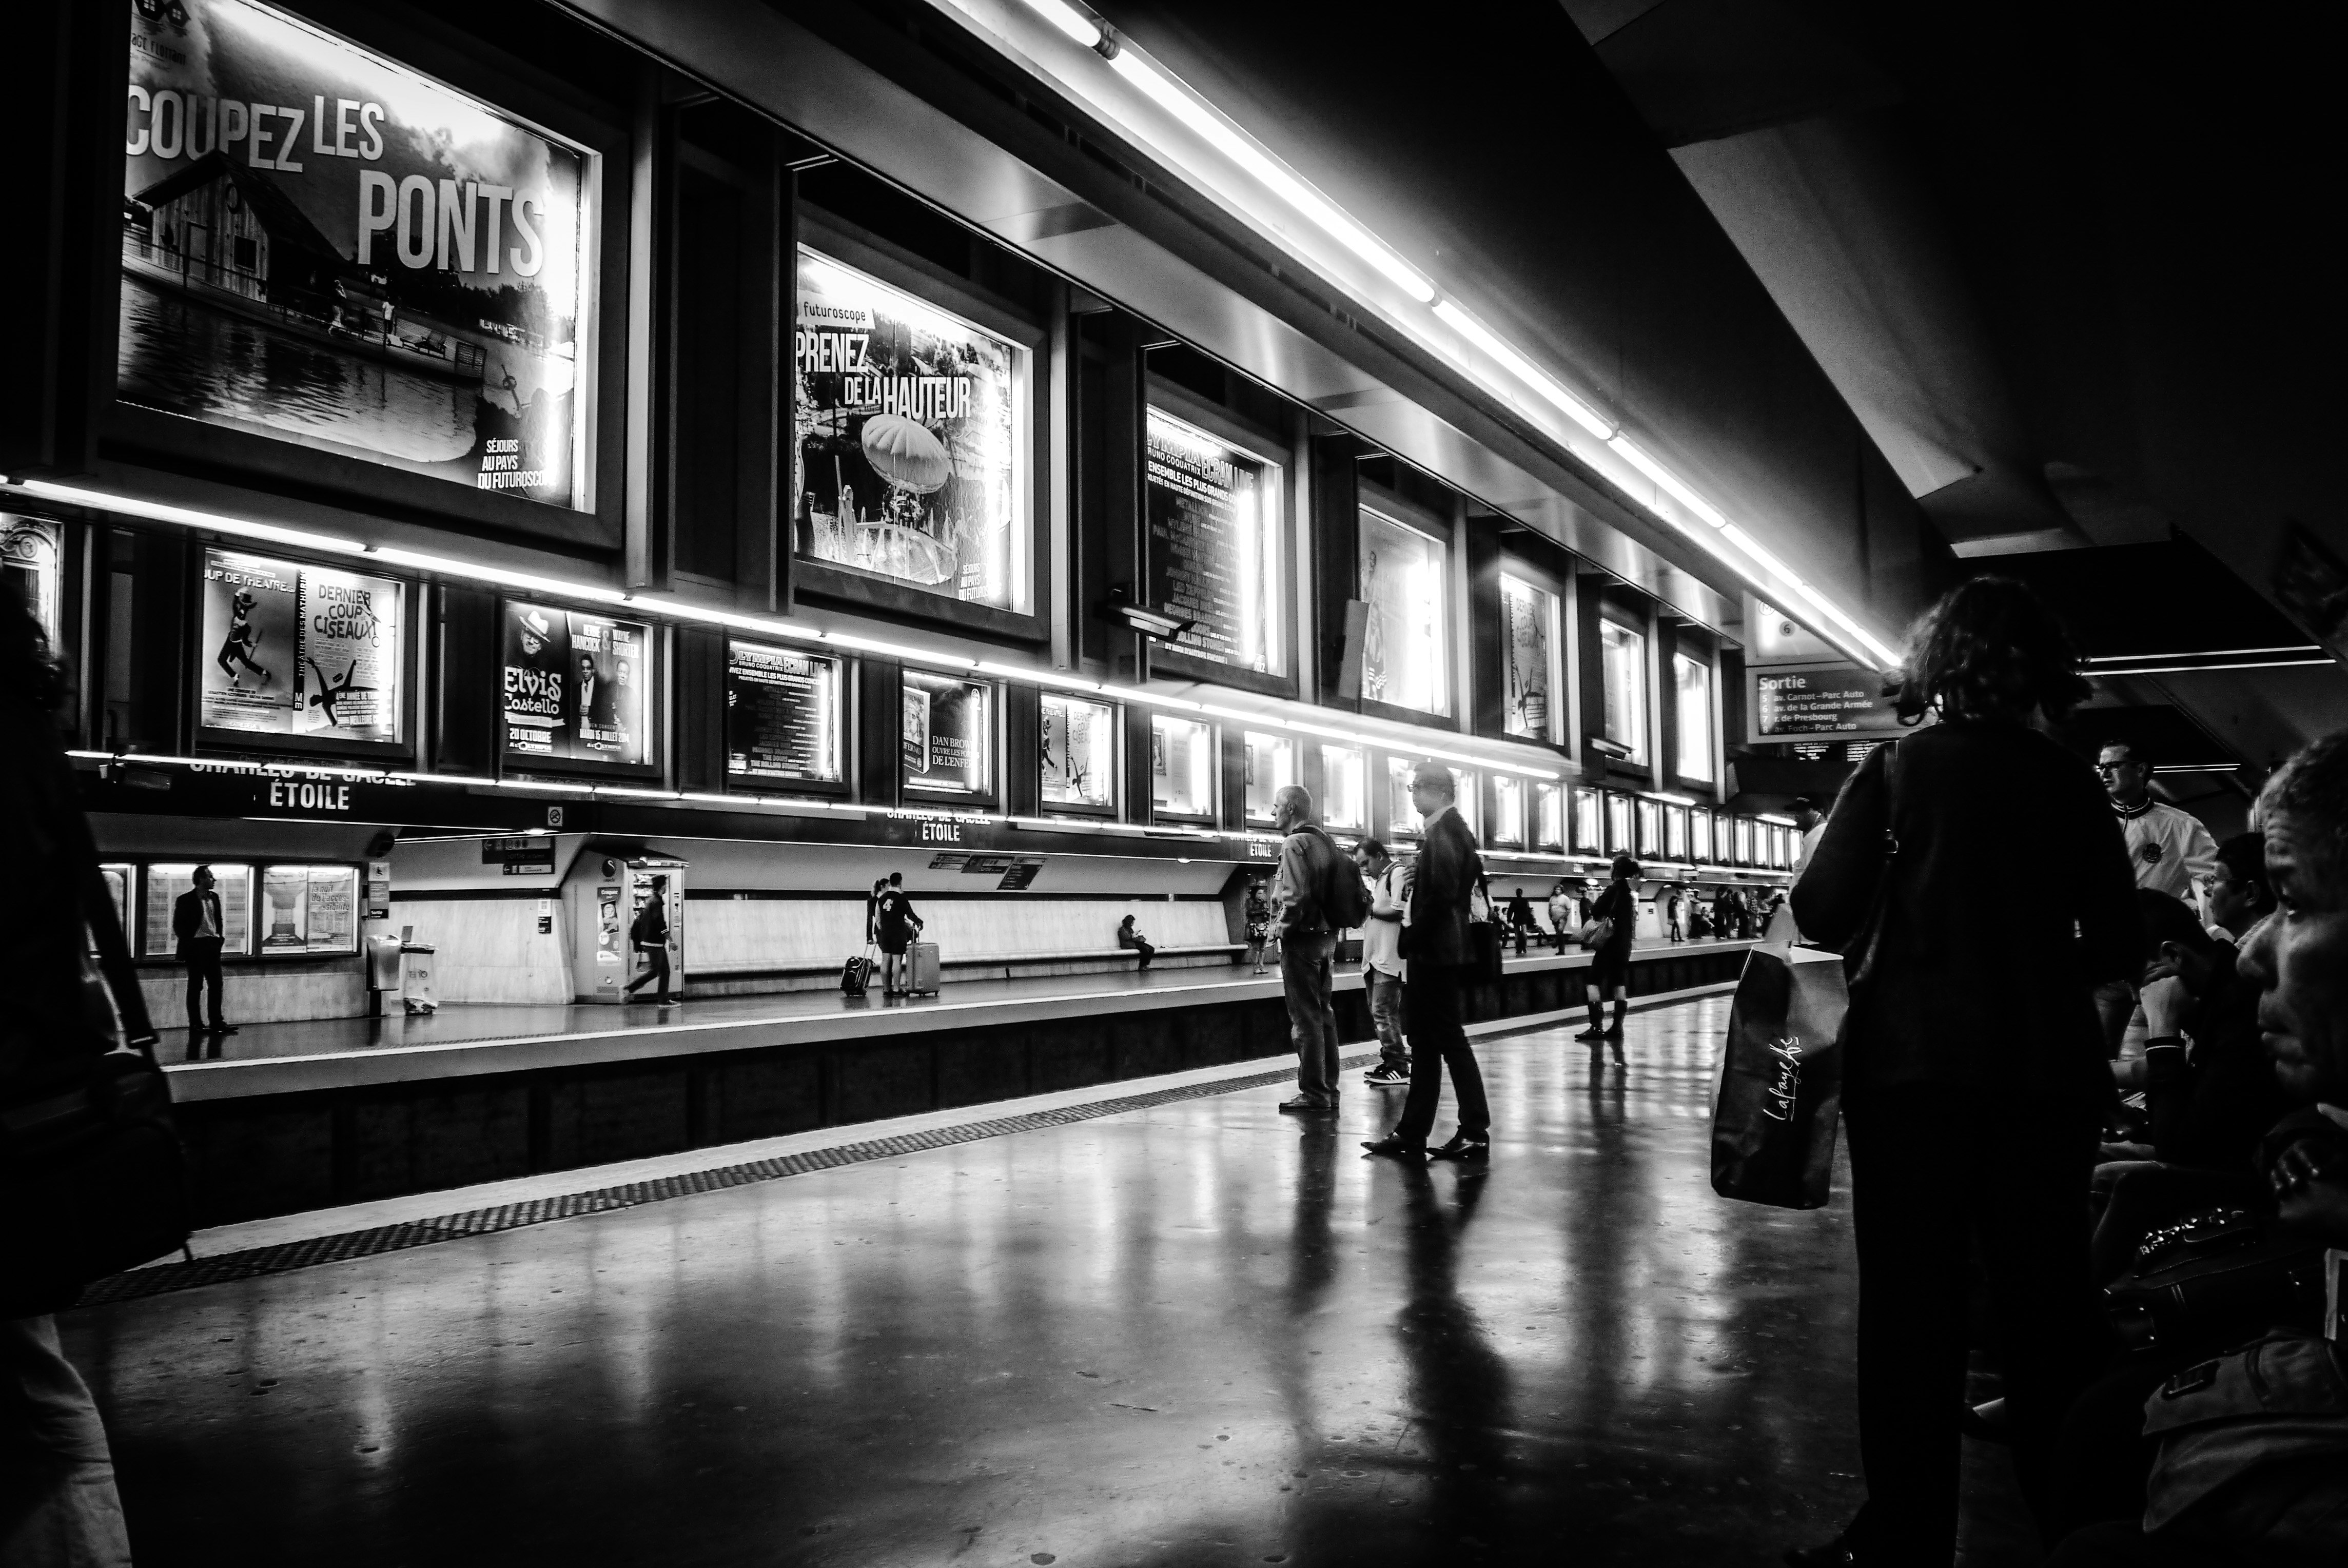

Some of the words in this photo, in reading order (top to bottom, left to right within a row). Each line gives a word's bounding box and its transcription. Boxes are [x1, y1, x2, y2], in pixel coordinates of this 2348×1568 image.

[126, 84, 305, 172] COUPEZ
[313, 95, 384, 161] LES
[358, 169, 544, 278] PONTS
[804, 301, 866, 323] futuroscope
[796, 331, 869, 373] PRENEZ
[845, 376, 862, 405] DE
[864, 377, 882, 405] LA
[883, 377, 971, 419] HAUTEUR
[487, 438, 518, 453] SÉJOURS
[482, 456, 495, 472] AU
[496, 455, 518, 471] PAYS
[1166, 455, 1201, 476] COQUATRIX
[478, 473, 492, 489] DU
[493, 469, 557, 488] FUTUROSCO
[1148, 461, 1181, 483] ENSEMBLE
[1182, 474, 1193, 487] LES
[1193, 479, 1207, 493] PLUS
[1207, 485, 1228, 502] GRANDS
[1170, 482, 1183, 494] HAUTE
[225, 572, 240, 584] DE
[319, 584, 370, 606] DERNIER
[328, 603, 362, 620] COUP
[314, 615, 375, 640] CISEAUX
[742, 668, 768, 678] ENSEMBLE
[768, 671, 776, 679] LES
[777, 673, 788, 681] PLUS
[788, 675, 805, 683] GRANDS
[756, 663, 784, 672] COQUATRIX
[1759, 675, 1806, 690] Sortie
[1810, 702, 1842, 710] Grande
[1844, 700, 1873, 709] Armée
[1794, 713, 1837, 721] Presbourg
[510, 728, 520, 739] 20
[520, 729, 552, 743] OCTOBRE
[932, 735, 949, 746] DAN
[950, 738, 973, 749] BROW
[932, 747, 950, 755] OUVRE
[932, 755, 944, 766] DE
[270, 778, 349, 810] ÉTOILE
[923, 821, 960, 841] ÉTOILE
[1250, 841, 1272, 857] ÉTOILE
